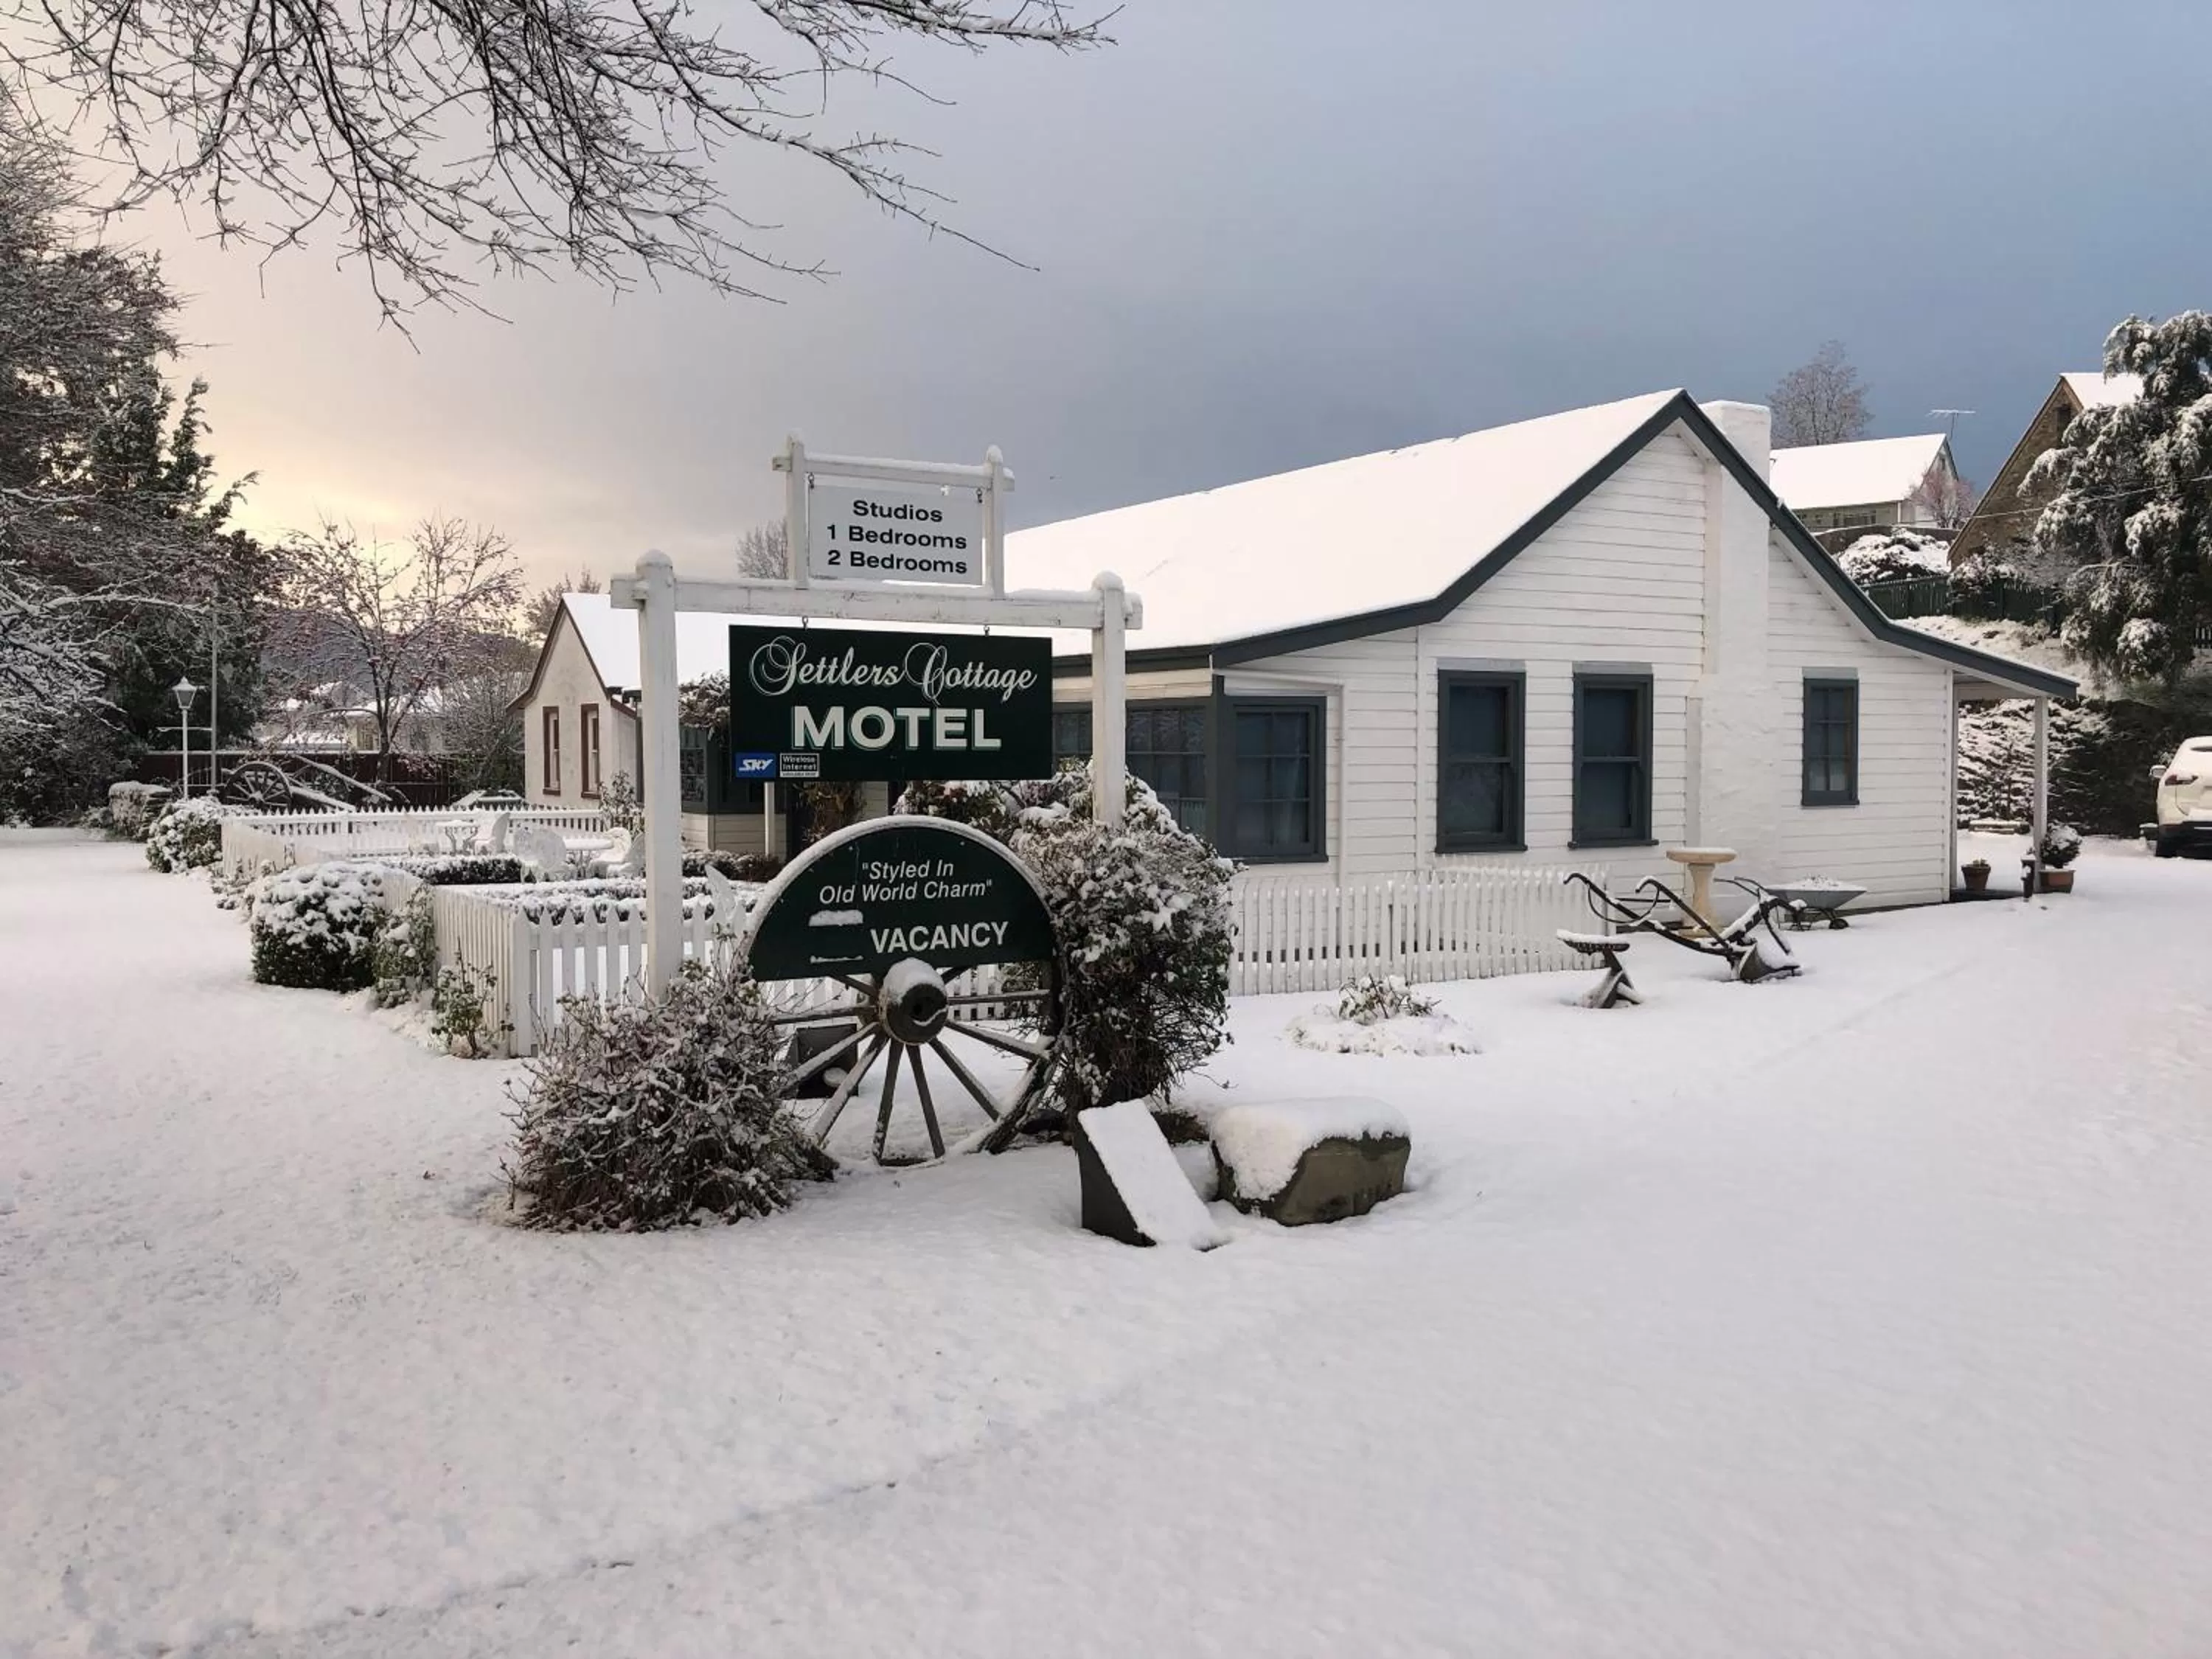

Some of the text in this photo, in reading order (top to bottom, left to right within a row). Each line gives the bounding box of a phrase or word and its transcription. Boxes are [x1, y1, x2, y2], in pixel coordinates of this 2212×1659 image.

[852, 500, 943, 522] Studios
[827, 524, 967, 549] 1 Bedrooms
[827, 550, 967, 574] 2 Bedrooms
[750, 635, 1037, 705] Settlers Cottage
[791, 706, 1002, 751] MOTEL
[738, 759, 773, 771] SKY
[936, 859, 954, 877] In
[819, 885, 855, 905] Old
[862, 881, 917, 902] World
[870, 921, 1009, 954] VACANCY
